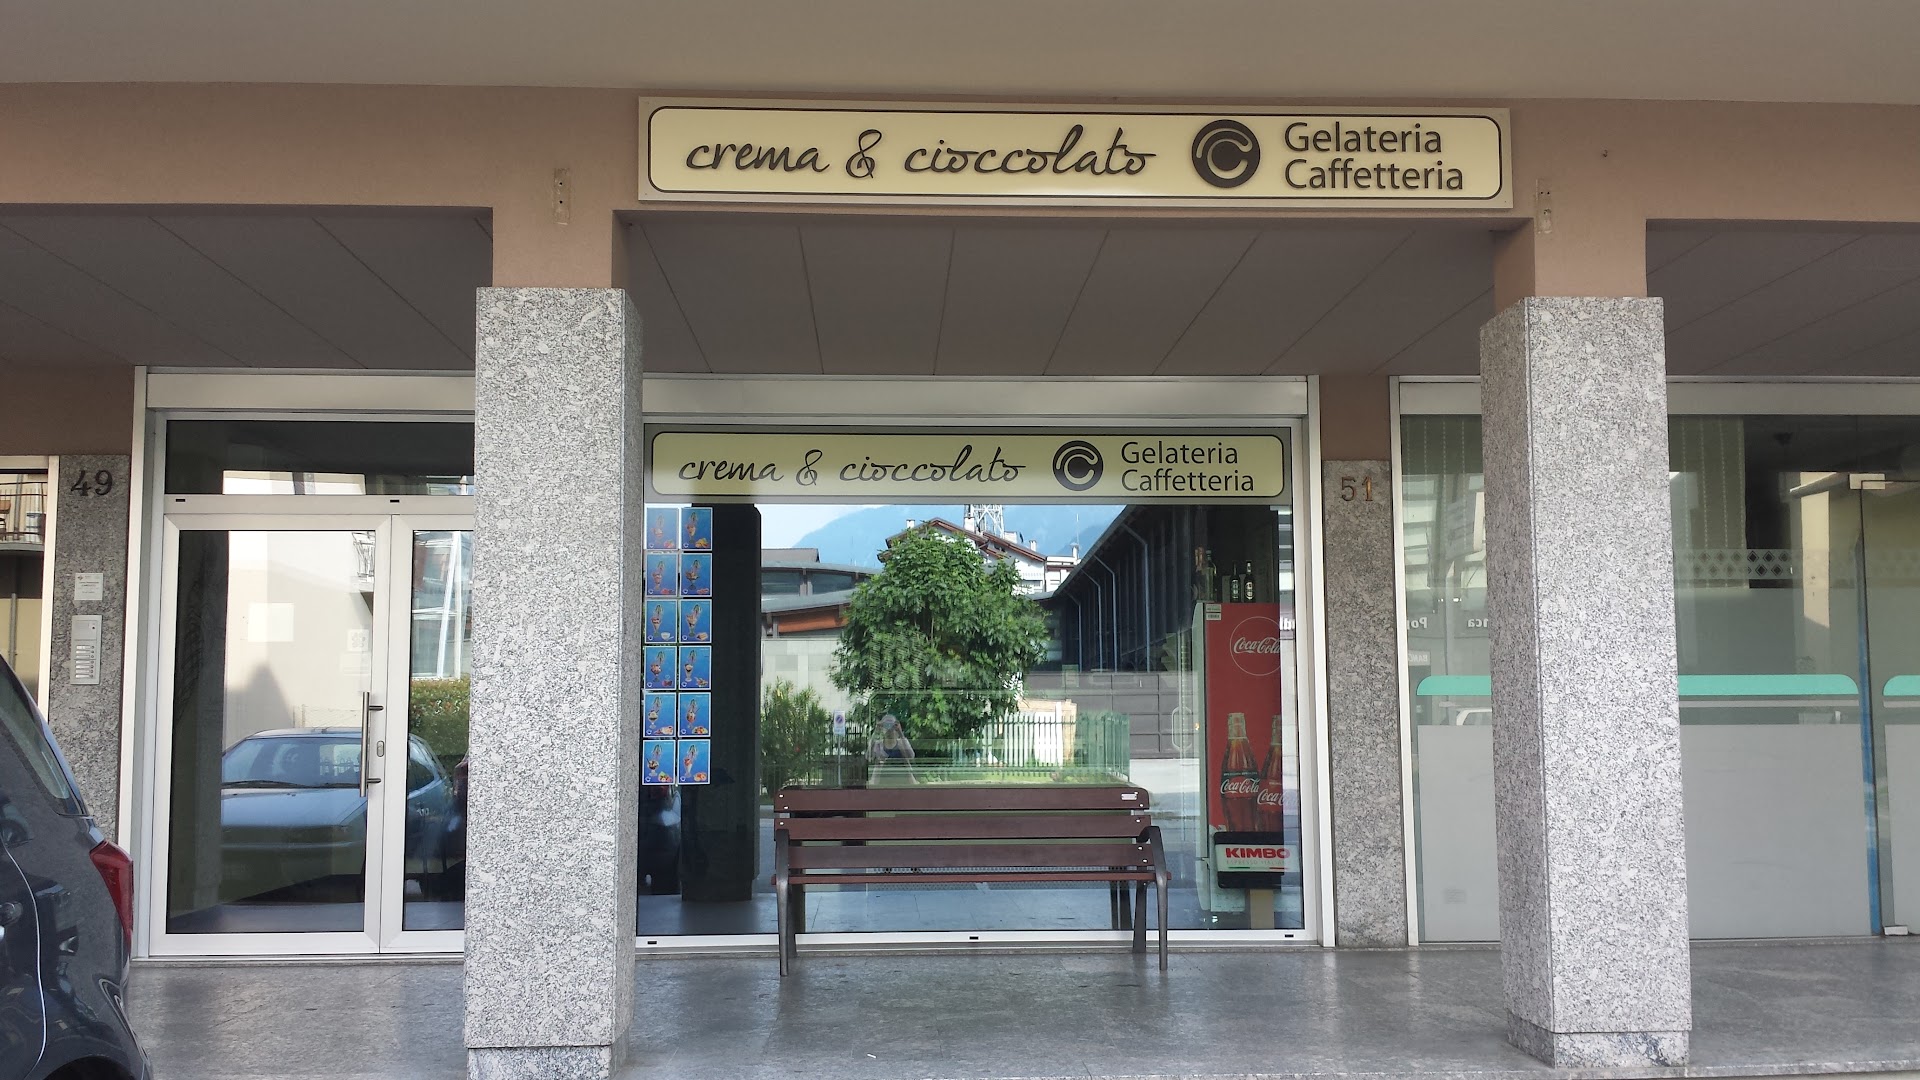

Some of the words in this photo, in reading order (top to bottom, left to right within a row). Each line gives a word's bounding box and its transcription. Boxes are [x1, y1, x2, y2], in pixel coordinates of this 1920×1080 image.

[1284, 120, 1443, 154] Gelateria
[686, 143, 830, 173] crema
[846, 128, 882, 179] &
[904, 124, 1157, 176] cioccolato
[1284, 158, 1463, 191] Caffetteria
[678, 459, 784, 482] crema
[795, 448, 823, 487] &
[839, 444, 1027, 484] cioccolato
[1121, 440, 1238, 465] Gelateria
[70, 469, 113, 497] 49
[1121, 468, 1254, 492] Caffetteria
[1341, 475, 1373, 502] 51
[1220, 778, 1260, 795] Coca-Cola
[1225, 847, 1291, 859] KIMBO
